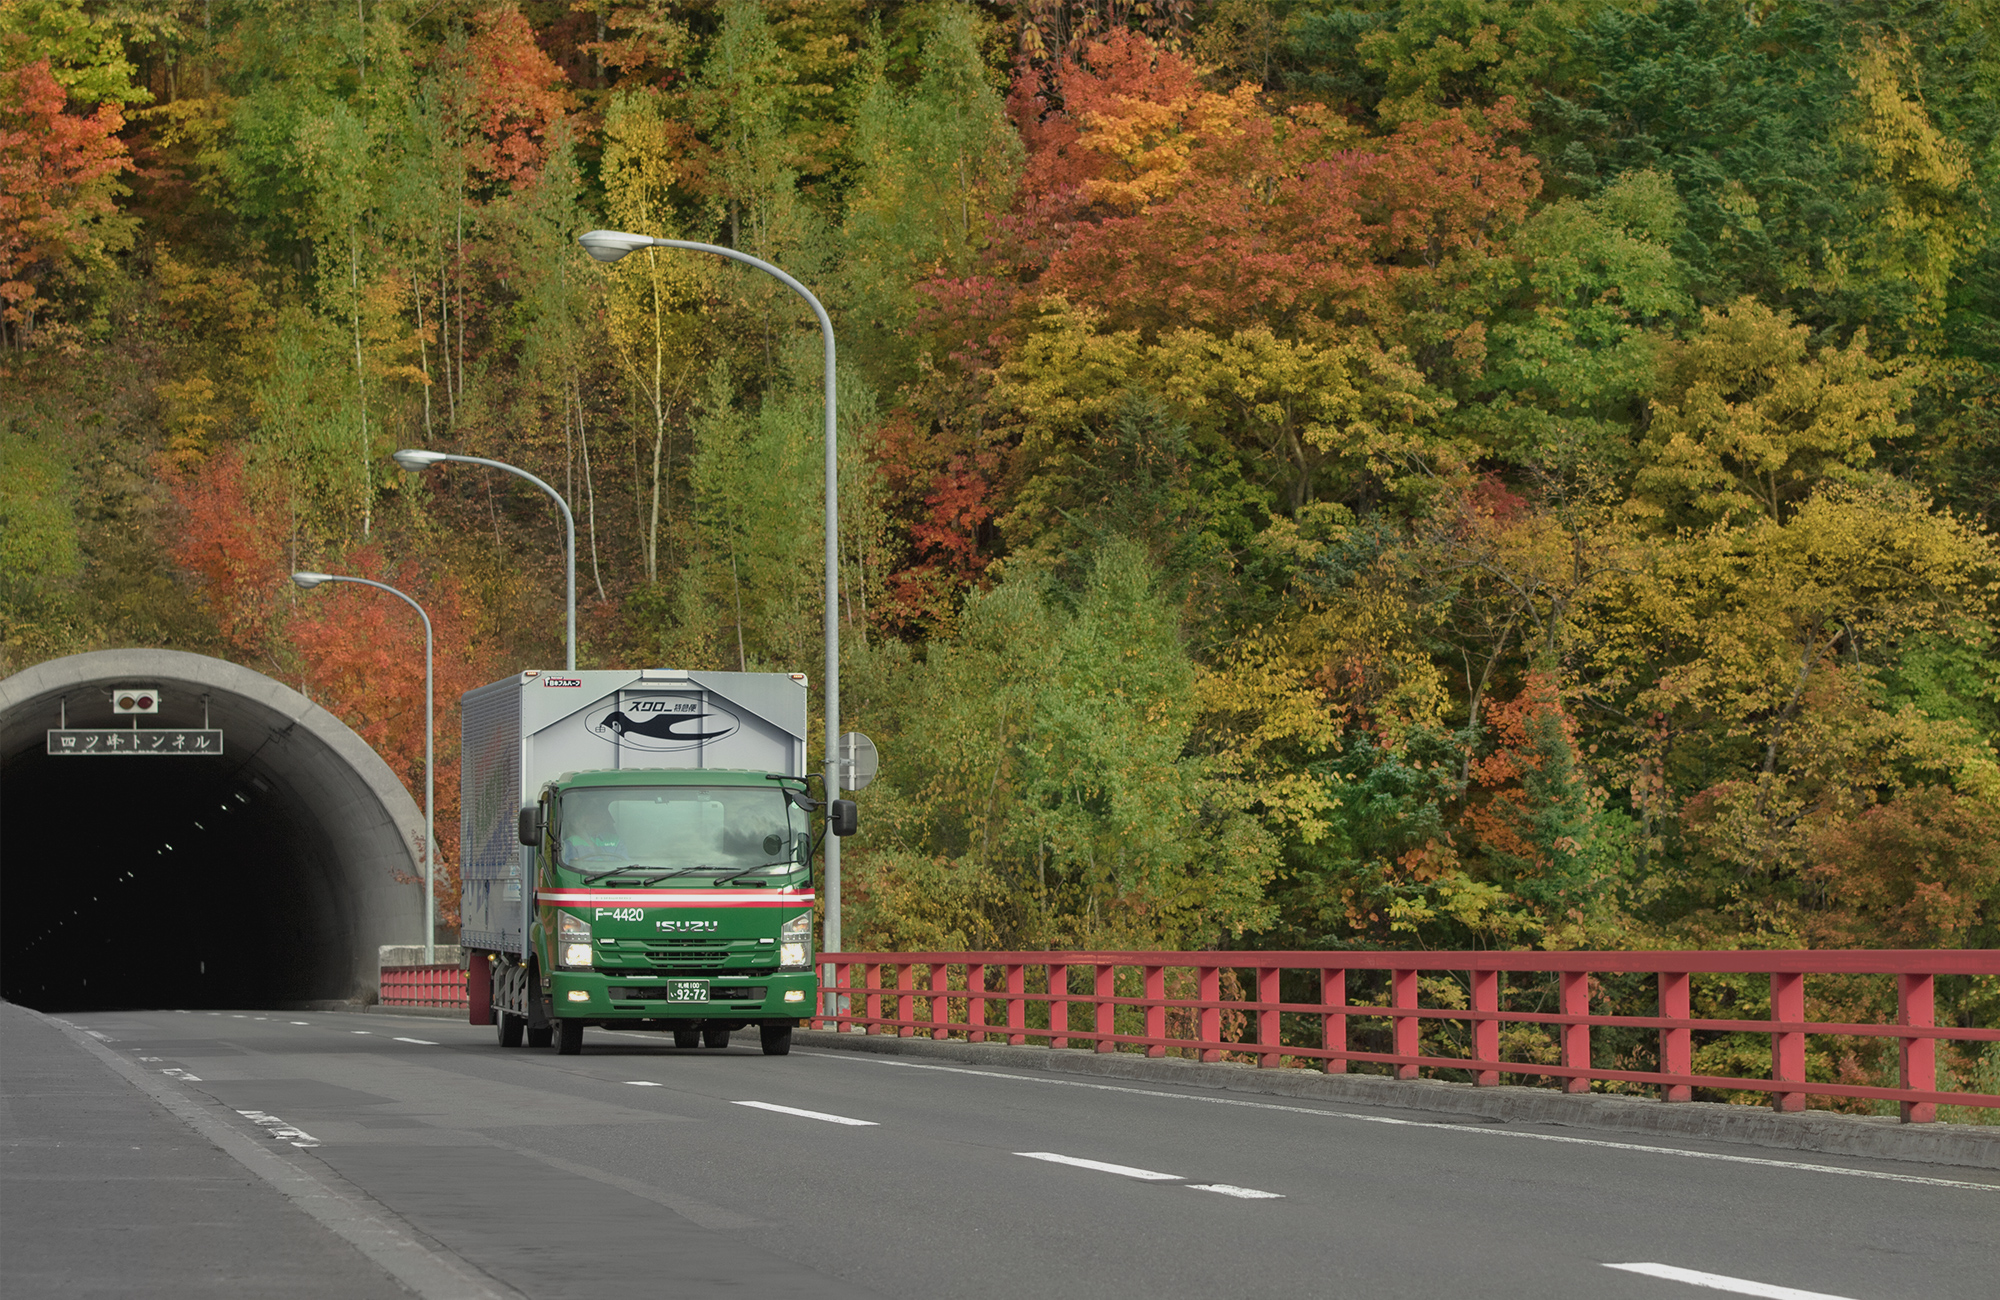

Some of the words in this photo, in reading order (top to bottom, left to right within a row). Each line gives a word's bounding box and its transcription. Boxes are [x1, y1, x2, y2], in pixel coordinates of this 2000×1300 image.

[60, 733, 211, 750] 四ツ峰トンネル
[595, 907, 644, 922] F-4420
[655, 920, 719, 933] ISUZU
